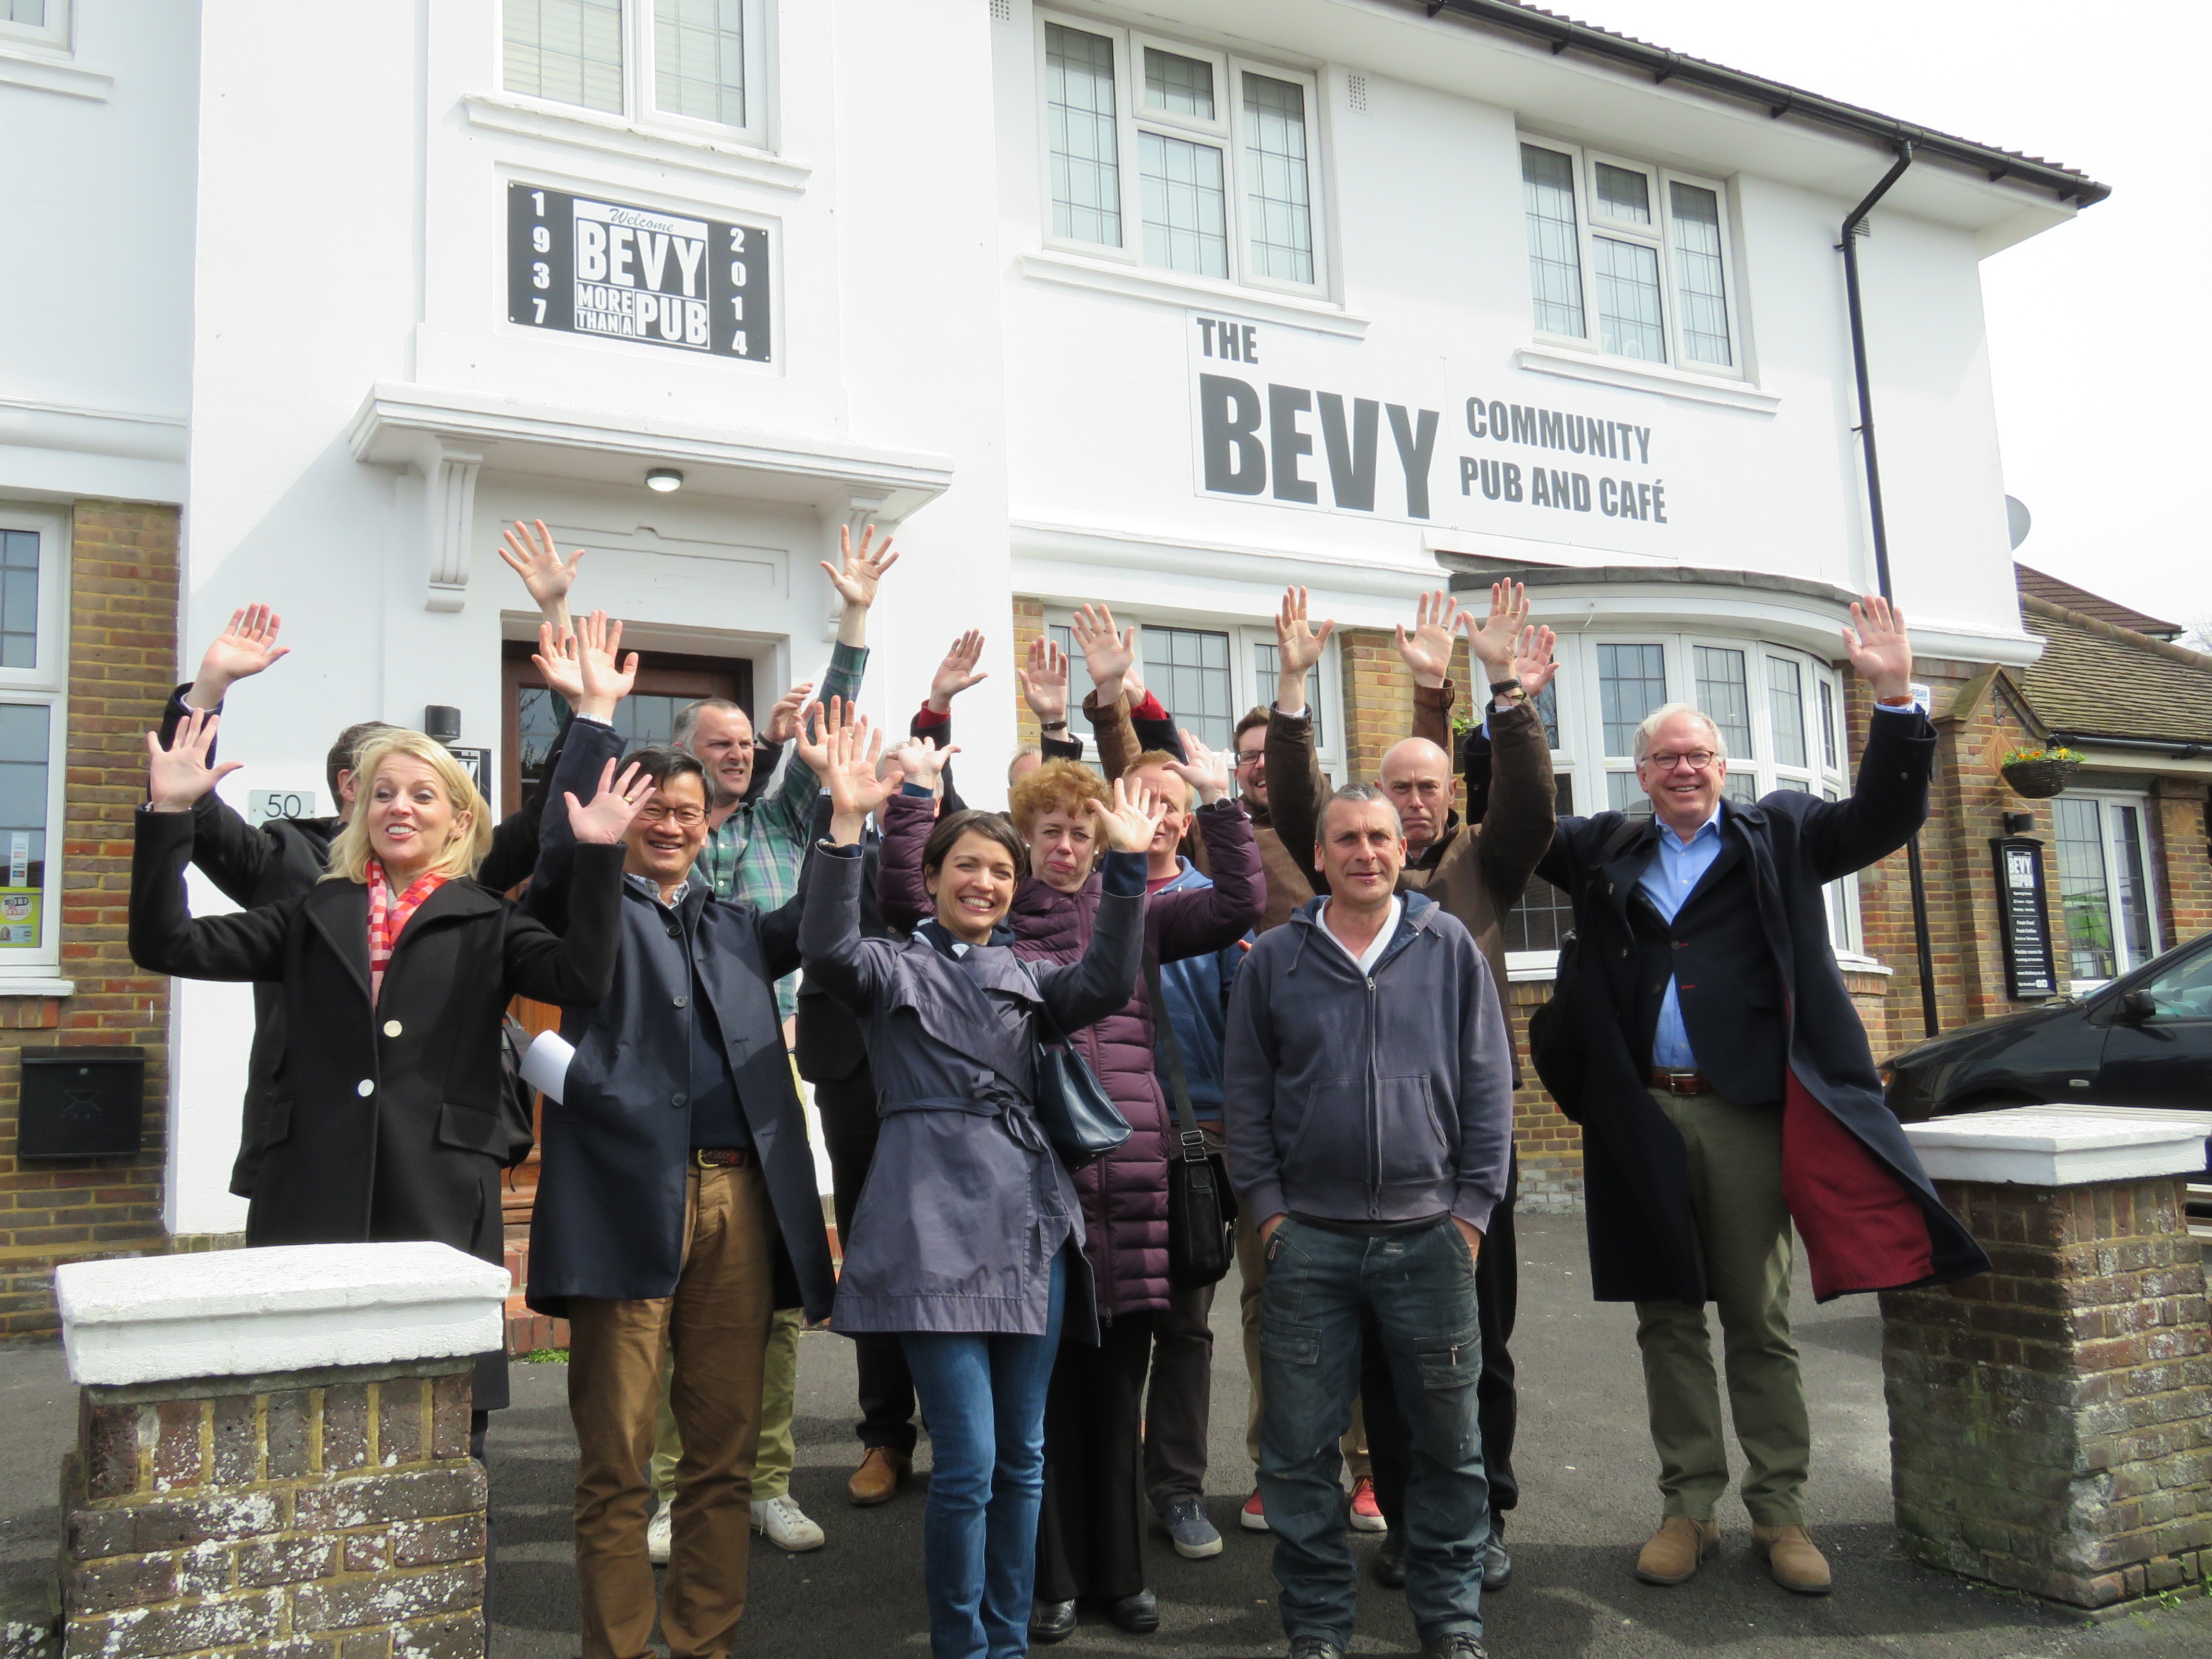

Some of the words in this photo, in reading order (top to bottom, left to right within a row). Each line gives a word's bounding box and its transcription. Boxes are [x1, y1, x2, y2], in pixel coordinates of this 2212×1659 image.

[608, 207, 674, 232] Welcome
[577, 219, 704, 297] BEVY
[577, 283, 633, 314] MORE
[265, 314, 301, 338] 50
[577, 309, 619, 333] THAN
[623, 316, 633, 335] A
[636, 292, 708, 345] PUB
[1196, 317, 1259, 365] THE
[1199, 373, 1440, 520] BEVY
[1466, 397, 1651, 465] COMMUNITY
[1459, 456, 1523, 503] PUB
[1531, 467, 1592, 512] AND
[1599, 478, 1668, 524] CAFÉ
[2008, 857, 2031, 874] BEVY
[2020, 874, 2034, 887] PUB
